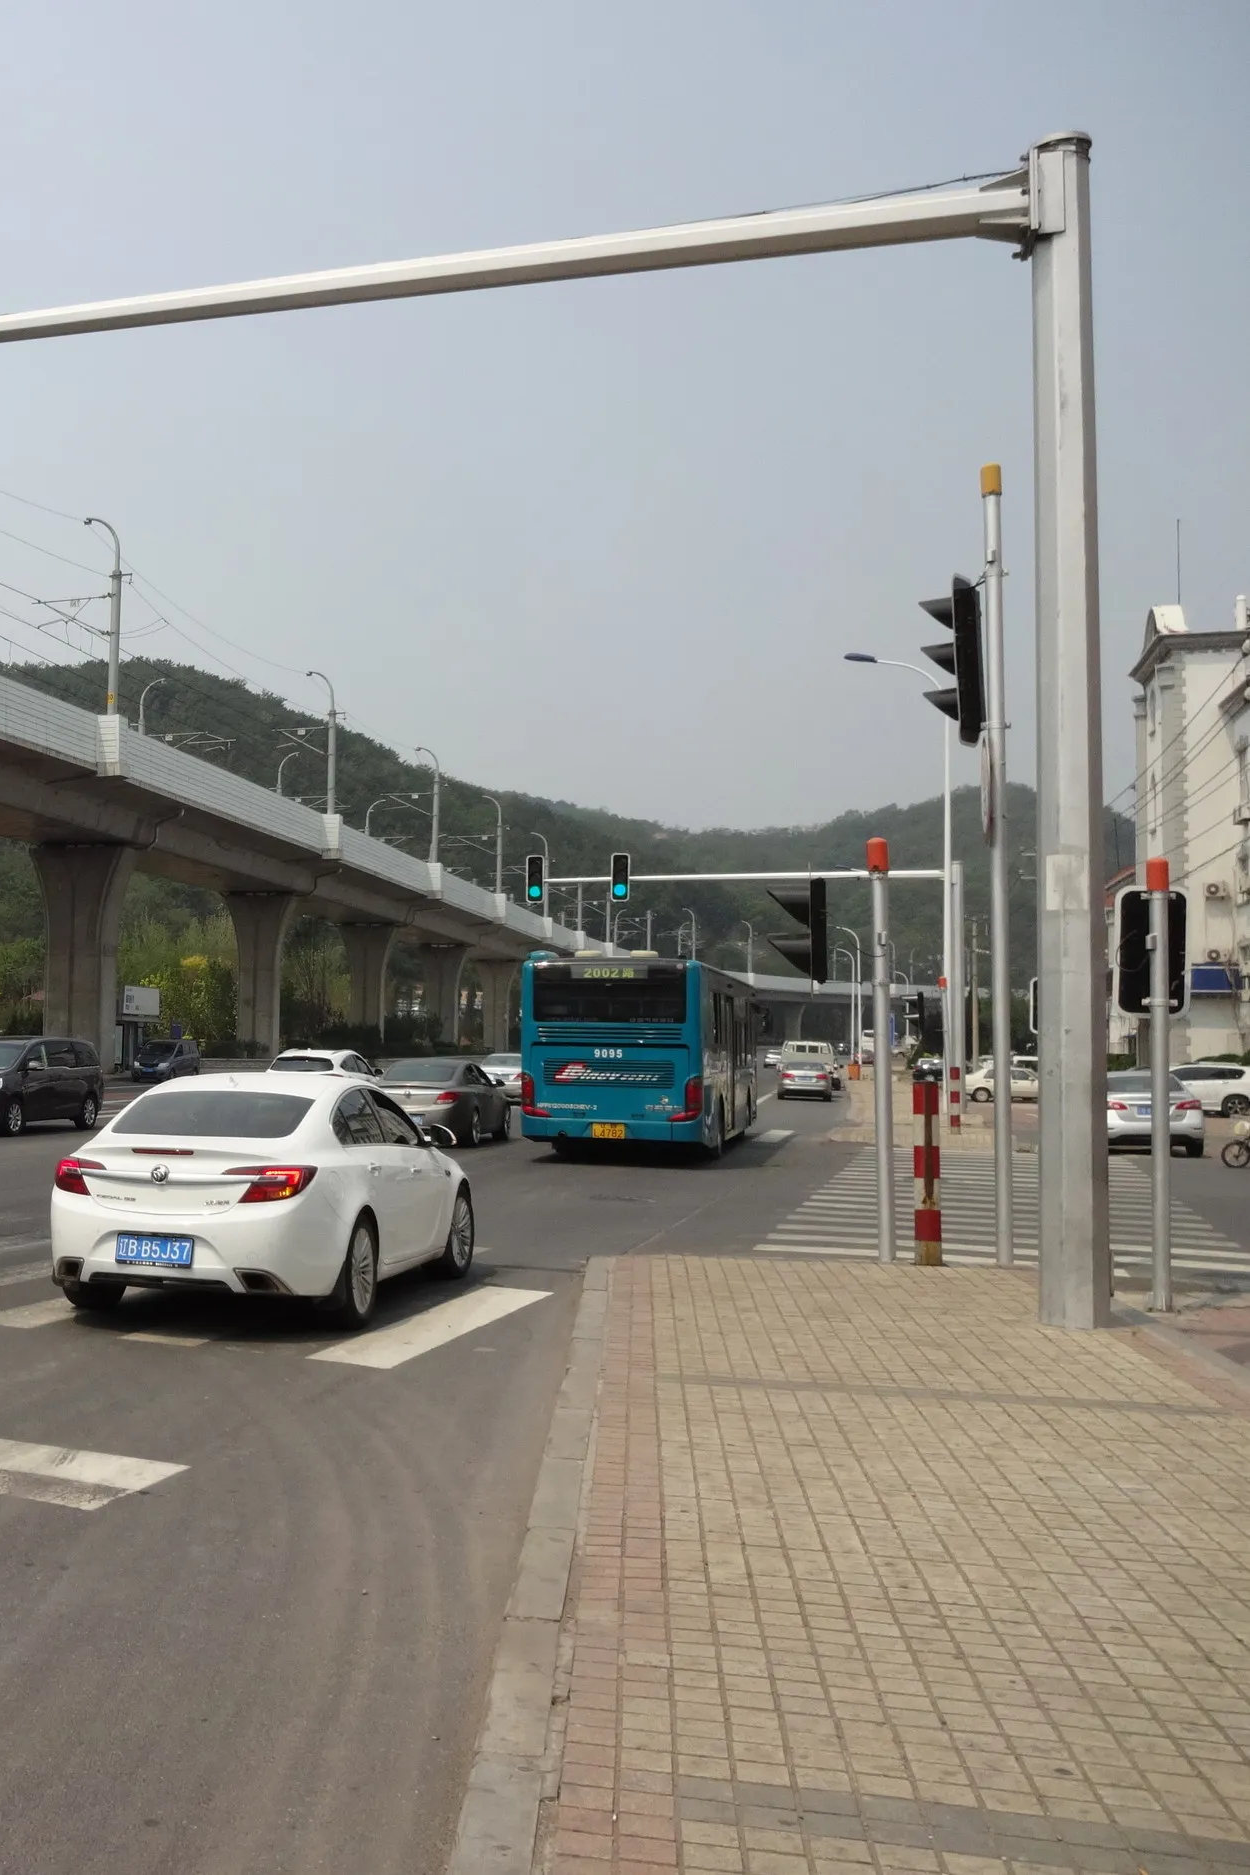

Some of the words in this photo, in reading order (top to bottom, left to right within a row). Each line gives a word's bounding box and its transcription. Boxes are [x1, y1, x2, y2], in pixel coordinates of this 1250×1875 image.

[583, 968, 619, 978] 2002
[622, 968, 635, 979] 路
[594, 1049, 623, 1058] 9095
[593, 1129, 623, 1138] L4782
